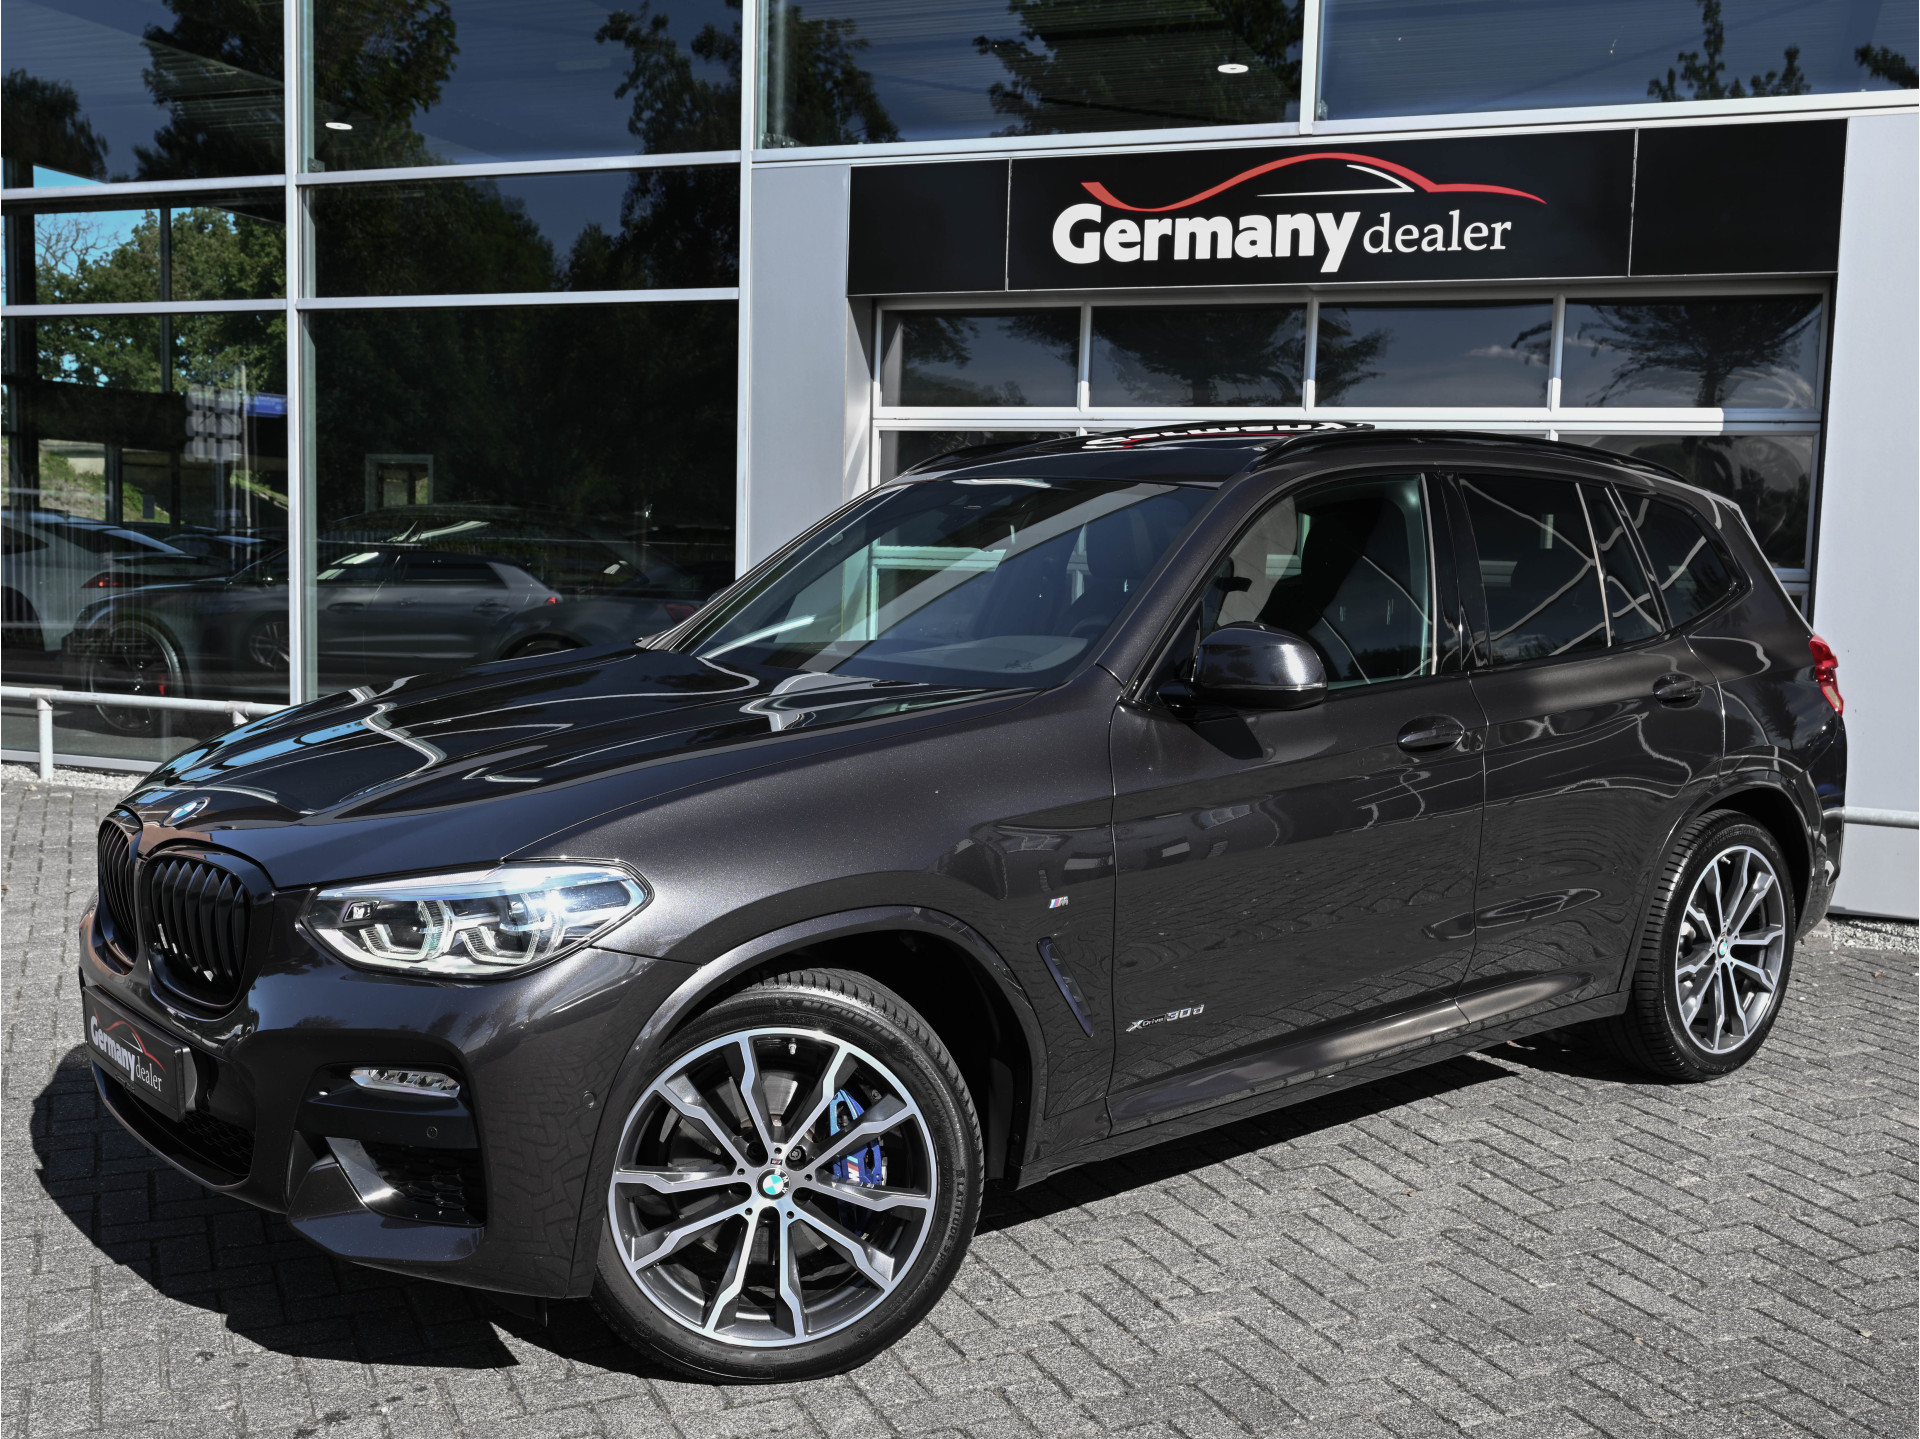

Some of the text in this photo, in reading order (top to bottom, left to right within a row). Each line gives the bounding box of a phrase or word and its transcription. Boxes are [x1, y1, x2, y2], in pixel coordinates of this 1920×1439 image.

[1052, 203, 1512, 273] Germany dealer
[90, 1015, 163, 1092] Germany dealer
